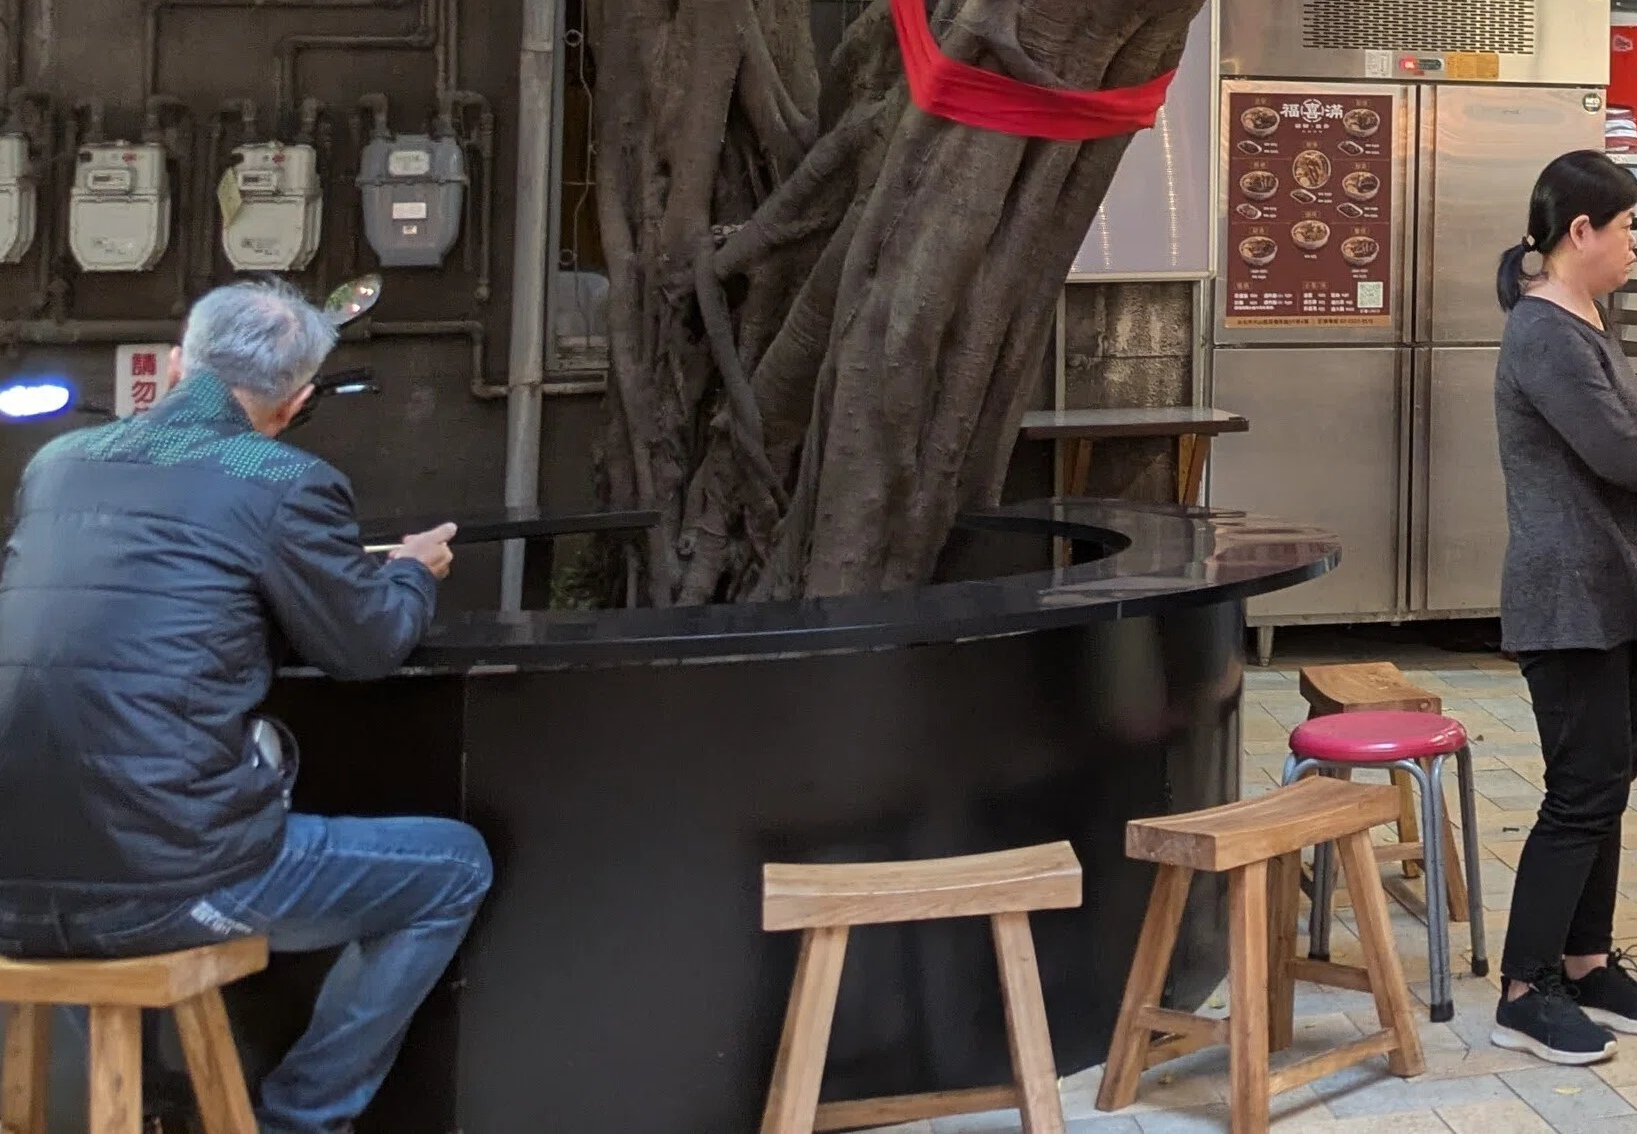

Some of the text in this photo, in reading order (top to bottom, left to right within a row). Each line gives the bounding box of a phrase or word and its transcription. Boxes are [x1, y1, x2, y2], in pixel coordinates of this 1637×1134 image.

[1280, 99, 1343, 123] 福喜滿
[131, 353, 157, 416] 請勿
